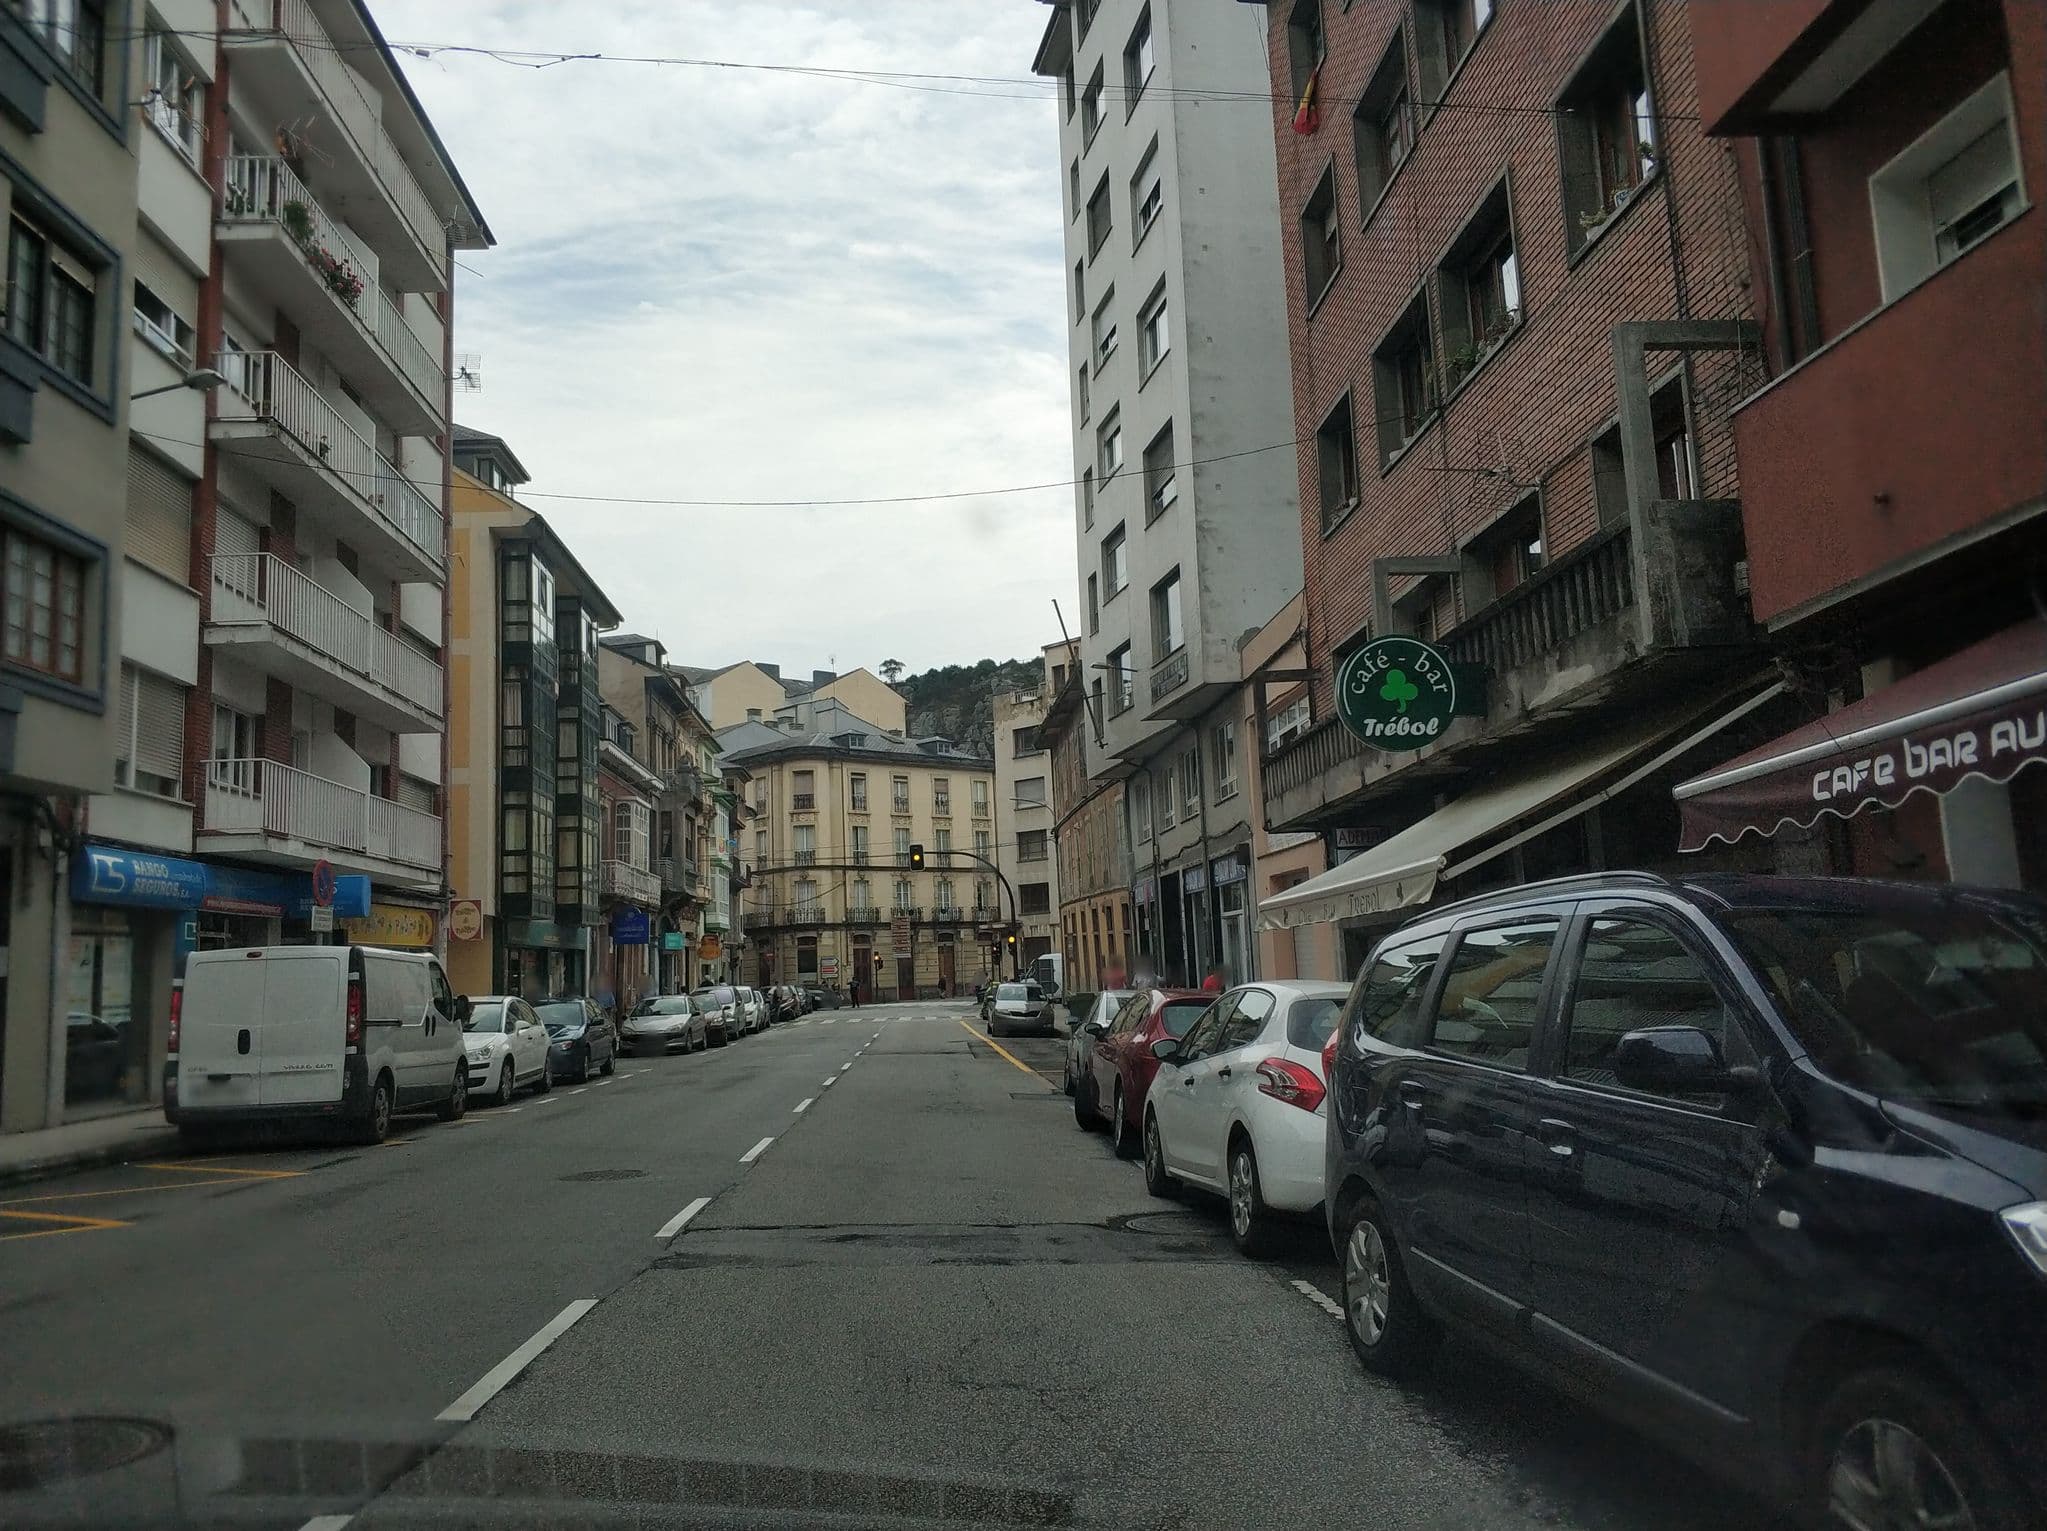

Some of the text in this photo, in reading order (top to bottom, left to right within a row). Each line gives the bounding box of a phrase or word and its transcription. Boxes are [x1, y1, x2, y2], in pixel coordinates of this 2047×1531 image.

[1351, 649, 1391, 694] café
[1414, 650, 1449, 693] bar
[1363, 716, 1439, 737] Trébol
